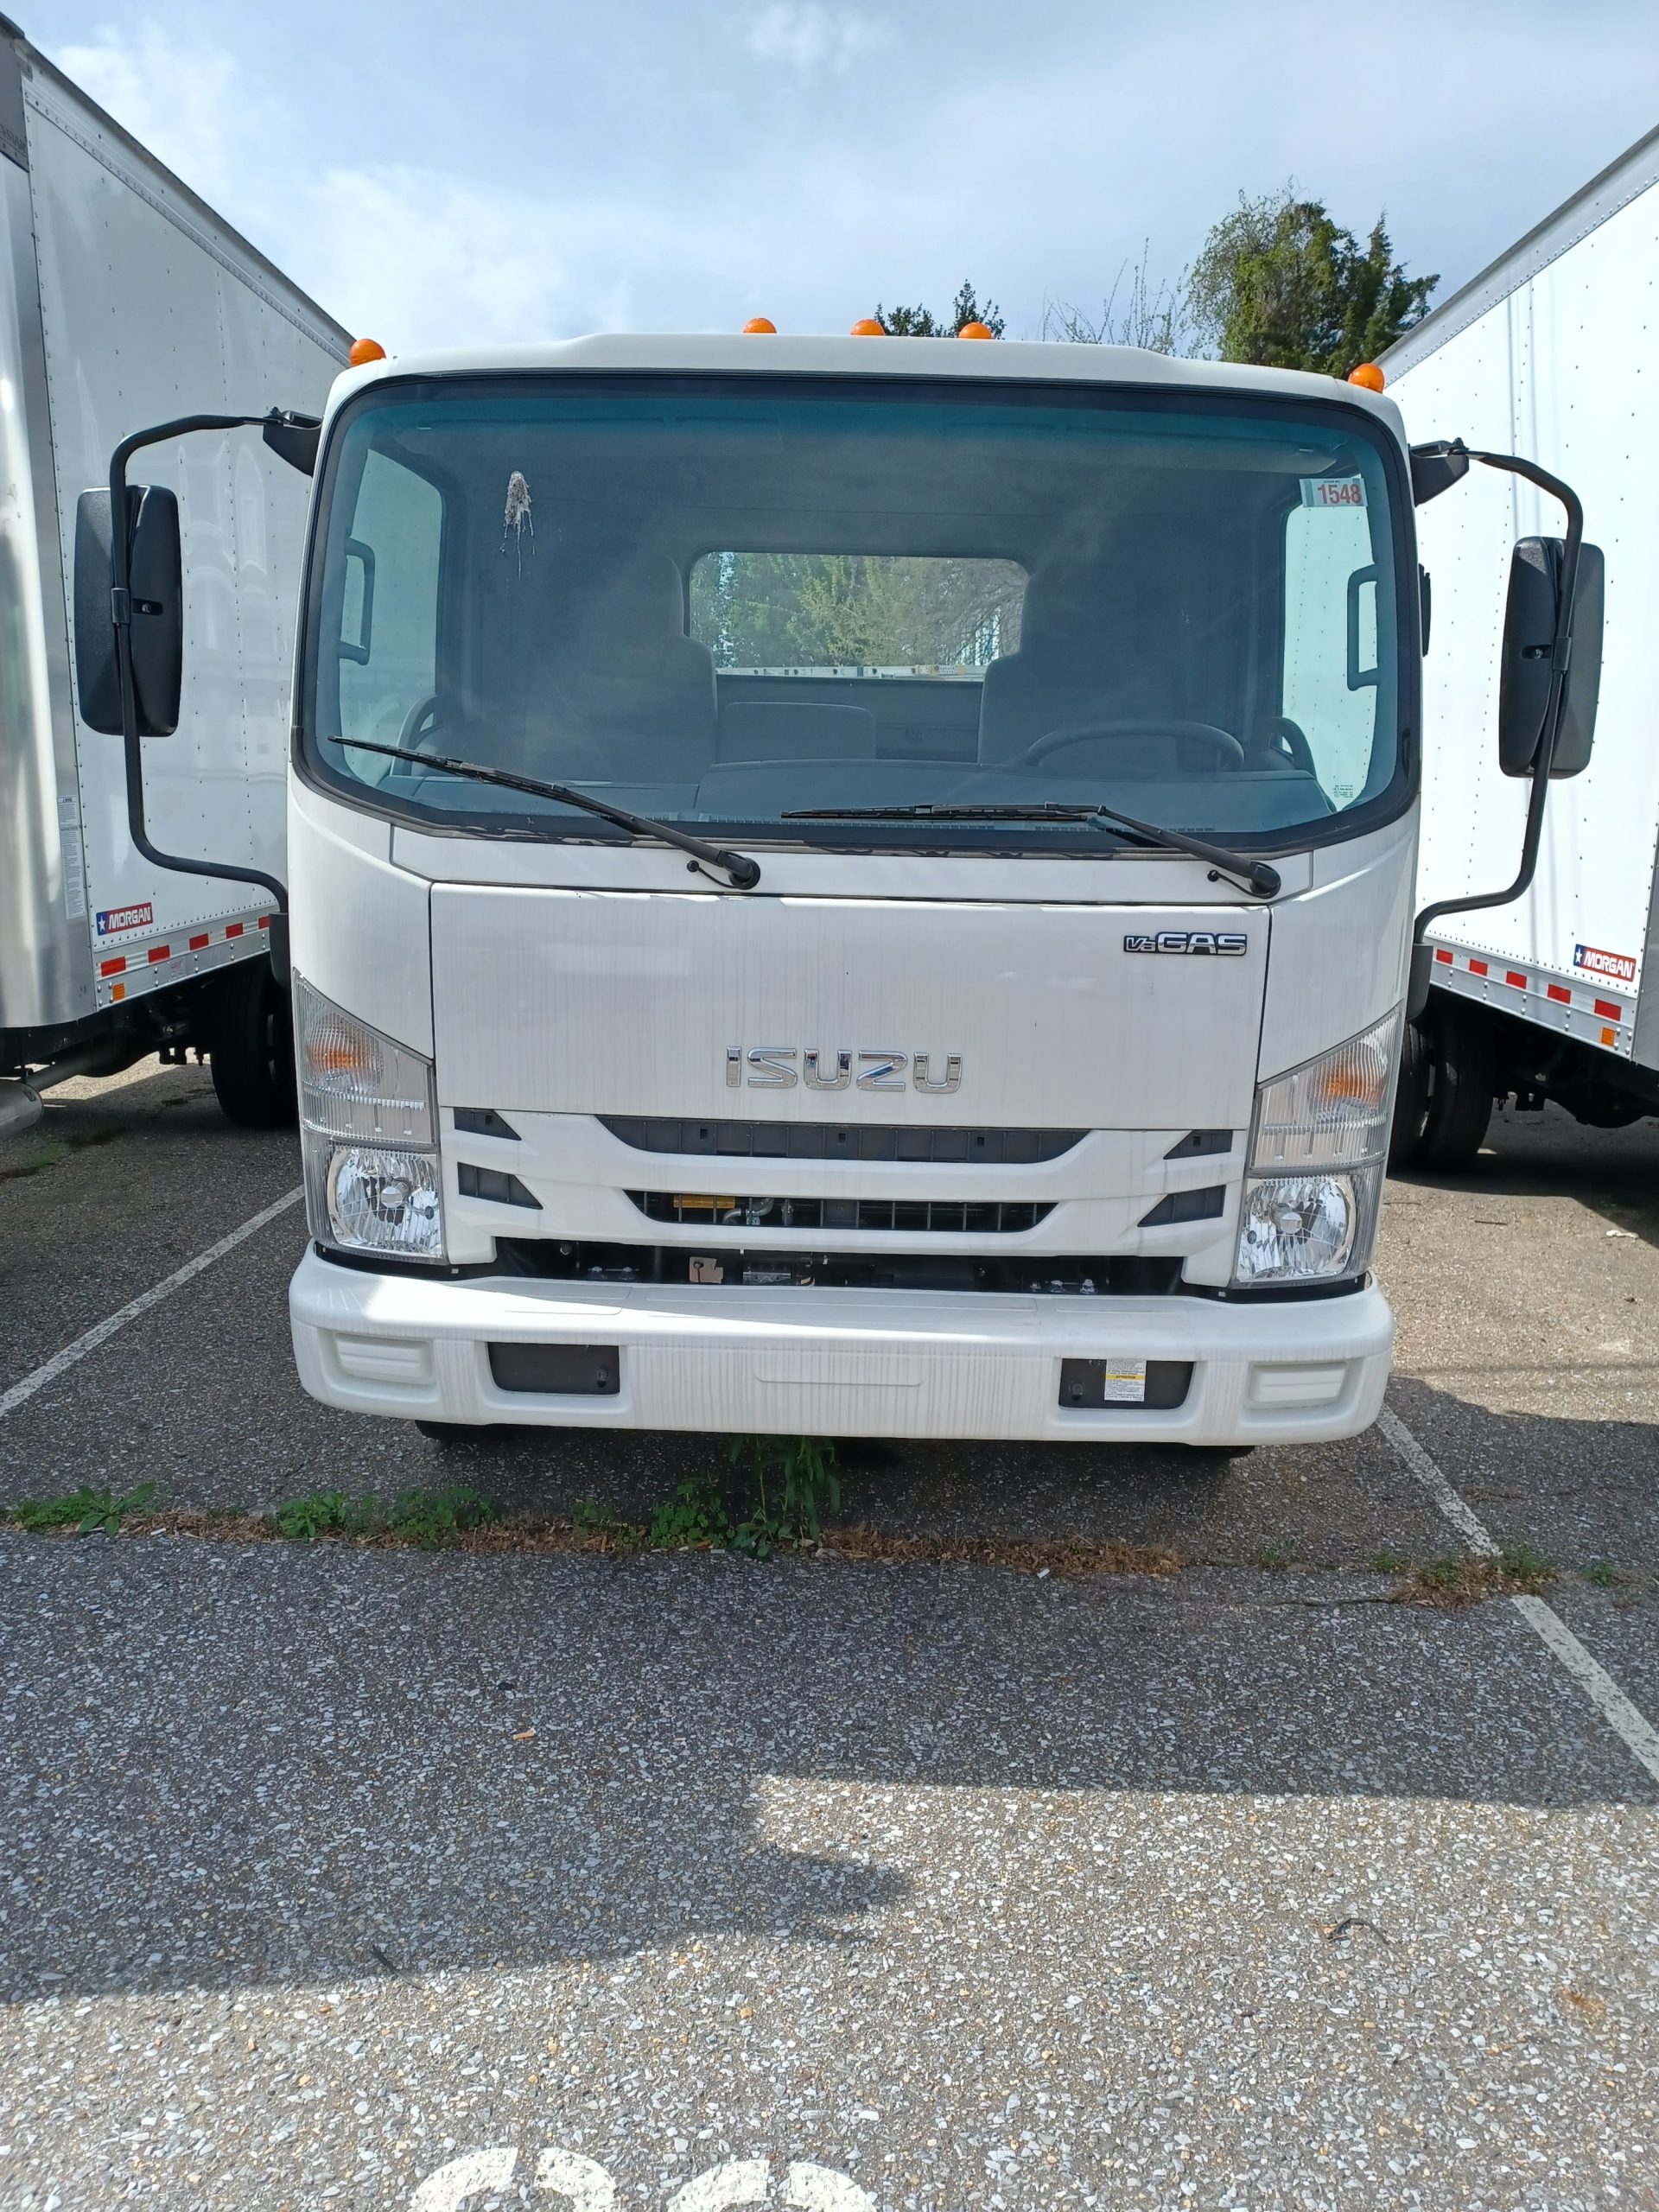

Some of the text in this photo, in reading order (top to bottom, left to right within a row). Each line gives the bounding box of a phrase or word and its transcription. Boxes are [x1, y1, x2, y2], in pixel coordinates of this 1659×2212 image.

[1317, 483, 1362, 505] 1548
[108, 906, 151, 930] MORGAN
[1157, 933, 1246, 955] GAS
[1583, 950, 1633, 979] MORGAN
[726, 1046, 963, 1095] ISUZU
